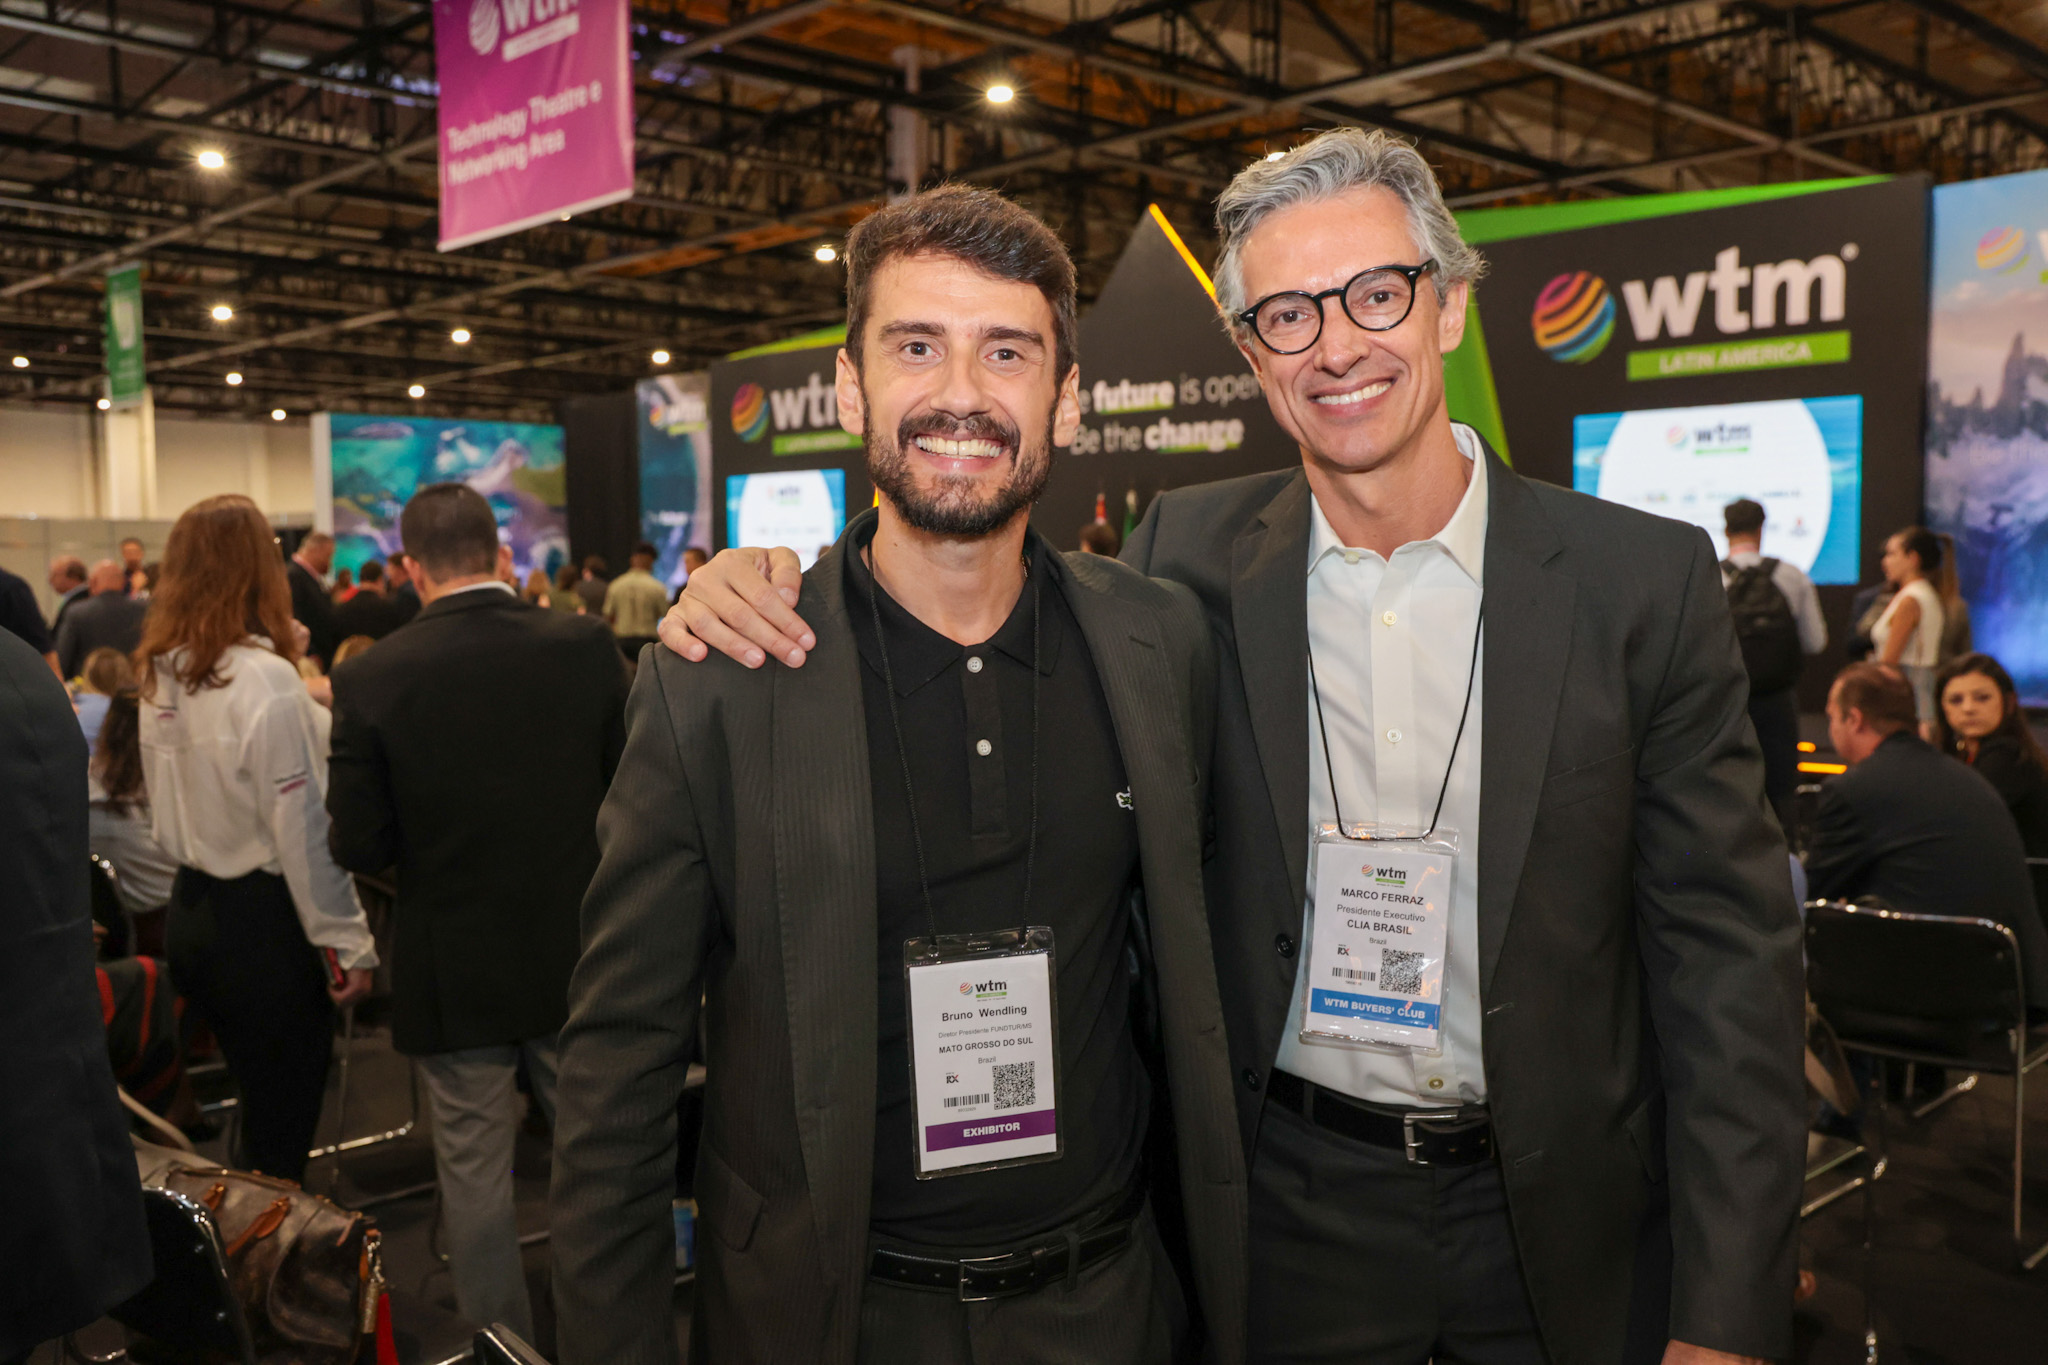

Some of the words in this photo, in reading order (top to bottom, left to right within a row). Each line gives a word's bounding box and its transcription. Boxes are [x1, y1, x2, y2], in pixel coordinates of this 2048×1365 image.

[1621, 245, 1847, 342] wtm
[1659, 350, 1715, 374] LATIN
[1718, 341, 1813, 367] AMERICA
[1093, 380, 1175, 412] future
[1180, 372, 1201, 404] is
[1104, 421, 1142, 453] the
[1144, 416, 1245, 453] change
[1376, 867, 1406, 878] wtm
[1341, 888, 1378, 900] MARCO
[1381, 892, 1424, 905] FERRAZ
[1337, 904, 1380, 917] Presidente
[1383, 909, 1425, 922] Executivo
[1347, 919, 1370, 930] CLIA
[1373, 922, 1412, 935] BRASIL
[1369, 937, 1386, 945] Brazil
[975, 979, 1006, 992] wtm
[942, 1011, 973, 1022] Bruno
[979, 1005, 1027, 1018] Wendling
[1324, 998, 1348, 1009] WTM
[1351, 1001, 1395, 1015] BUYERS'
[1397, 1006, 1426, 1019] CLUB
[938, 1031, 958, 1039] Diretor
[958, 1027, 990, 1036] Presidente
[991, 1023, 1032, 1032] FUNDTUR/MS
[939, 1045, 963, 1053] MATO
[965, 1041, 1000, 1051] GROSSO
[1003, 1039, 1015, 1047] DO
[1017, 1037, 1033, 1045] SUL
[977, 1056, 997, 1064] Brazil
[963, 1122, 1020, 1137] EXHIBITOR
